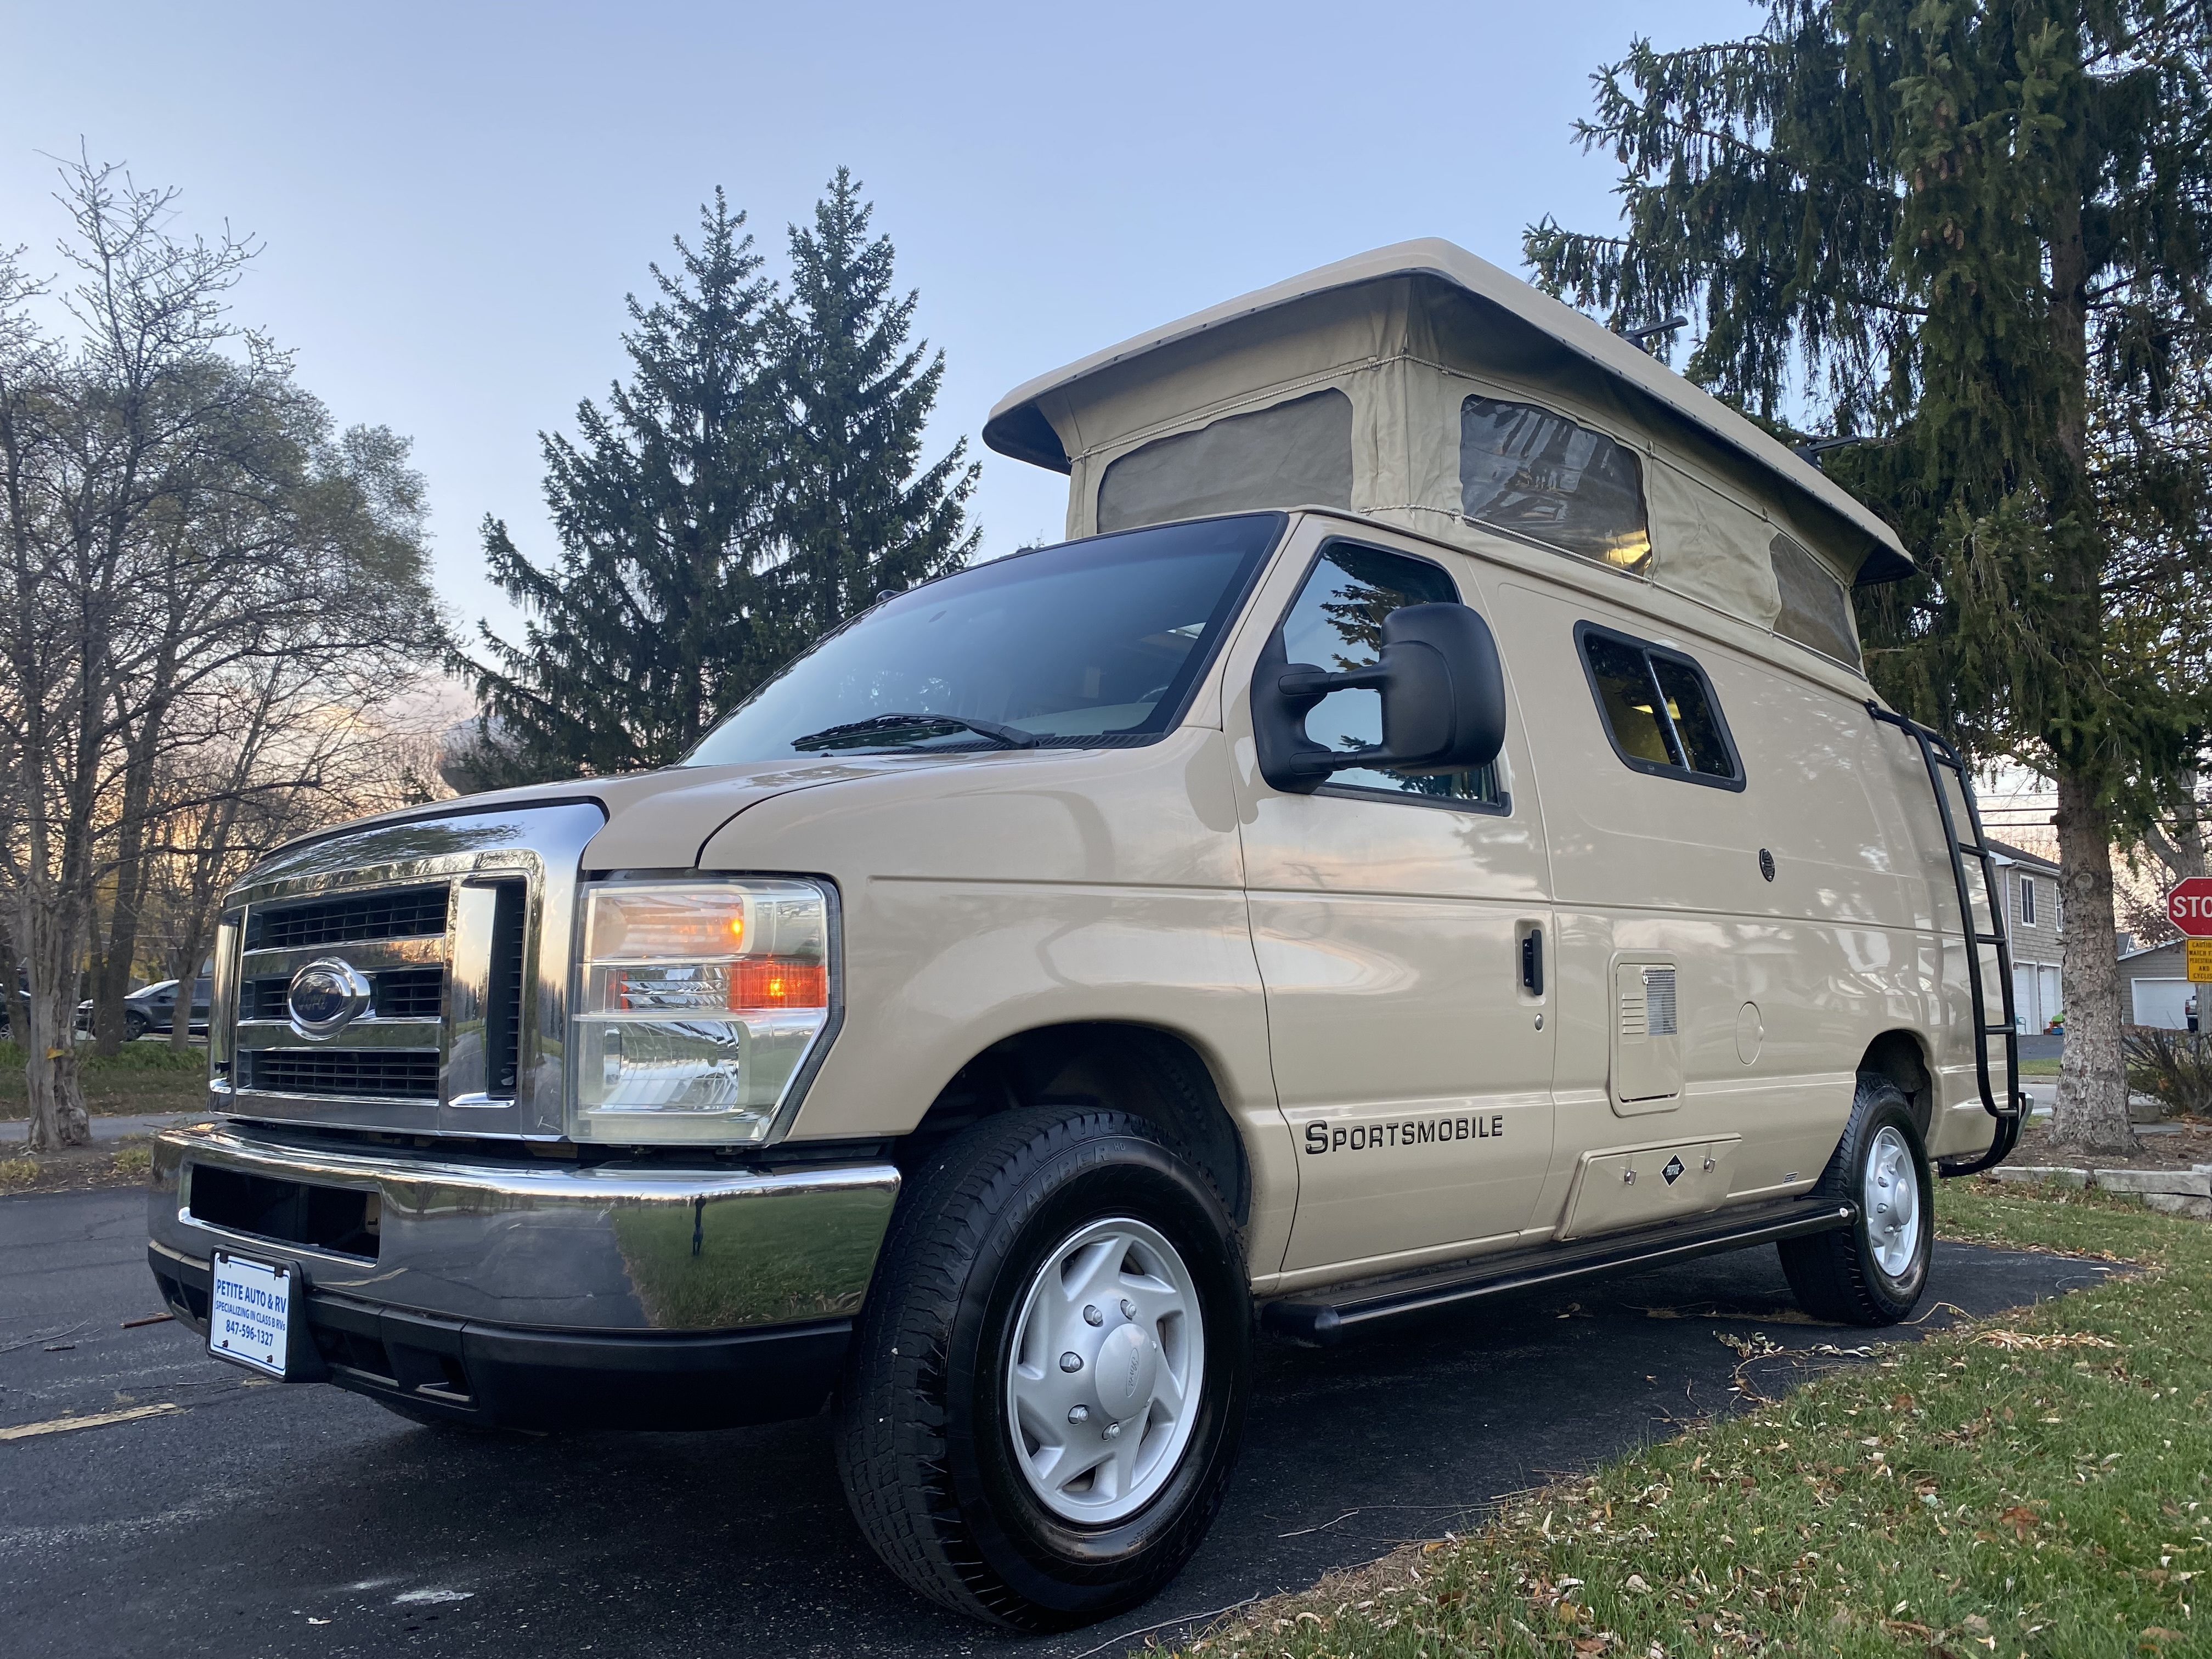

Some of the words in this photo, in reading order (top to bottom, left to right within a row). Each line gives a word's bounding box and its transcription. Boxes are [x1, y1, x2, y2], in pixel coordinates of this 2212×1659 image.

[2172, 896, 2212, 918] STO
[991, 1144, 1110, 1257] GRABBER
[1112, 1142, 1126, 1152] HD
[217, 1279, 243, 1300] PETITE
[245, 1286, 266, 1307] AUTO
[267, 1293, 274, 1310] &
[275, 1295, 286, 1313] RV
[216, 1300, 250, 1319] SPECIALIZING
[250, 1310, 256, 1321] IN
[256, 1312, 271, 1326] CLASS
[272, 1317, 275, 1328] B
[276, 1319, 285, 1331] RVs
[226, 1319, 273, 1347] 847-596-1327
